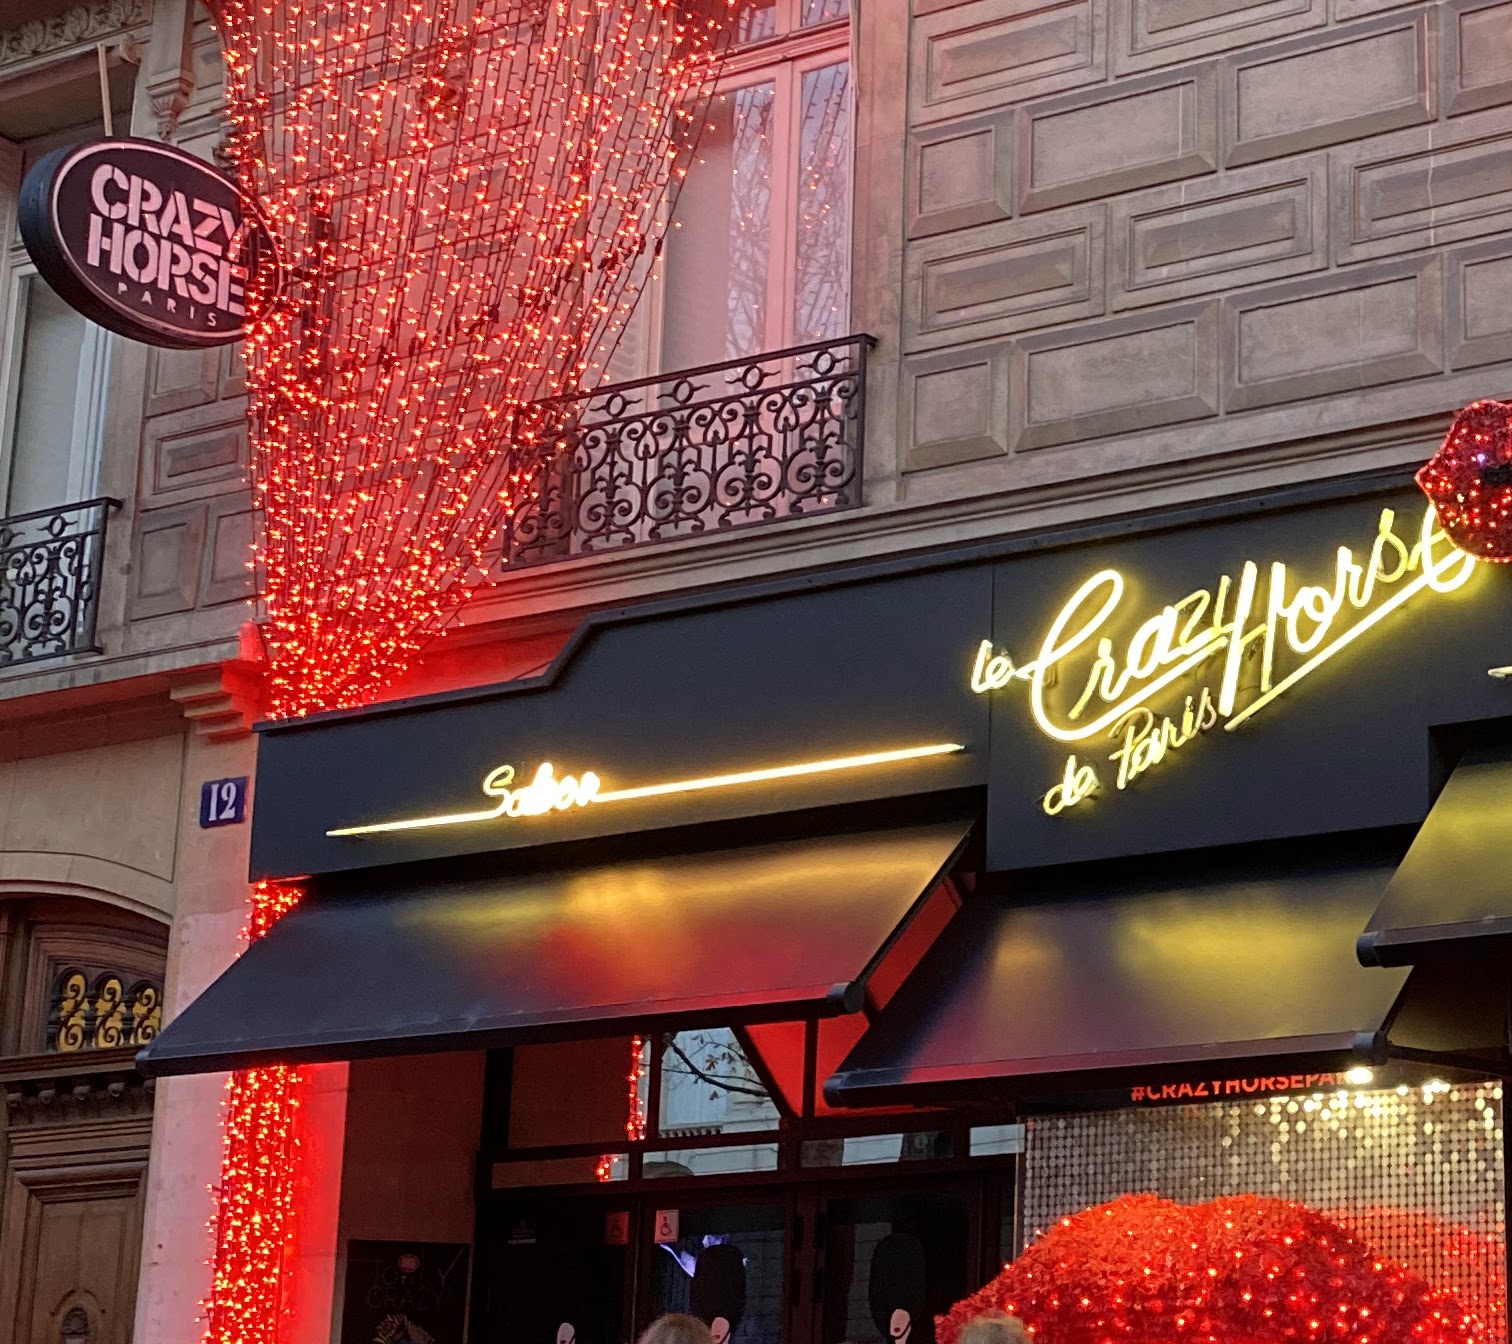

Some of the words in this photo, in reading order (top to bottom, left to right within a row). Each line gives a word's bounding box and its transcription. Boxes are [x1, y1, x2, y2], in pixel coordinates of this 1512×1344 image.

[90, 164, 249, 262] CRAZY
[87, 213, 249, 317] HORSE
[117, 282, 217, 327] PARIS
[1016, 569, 1257, 741] Crazy
[1043, 754, 1100, 815] de
[1109, 687, 1218, 790] Paris
[208, 782, 237, 822] 12
